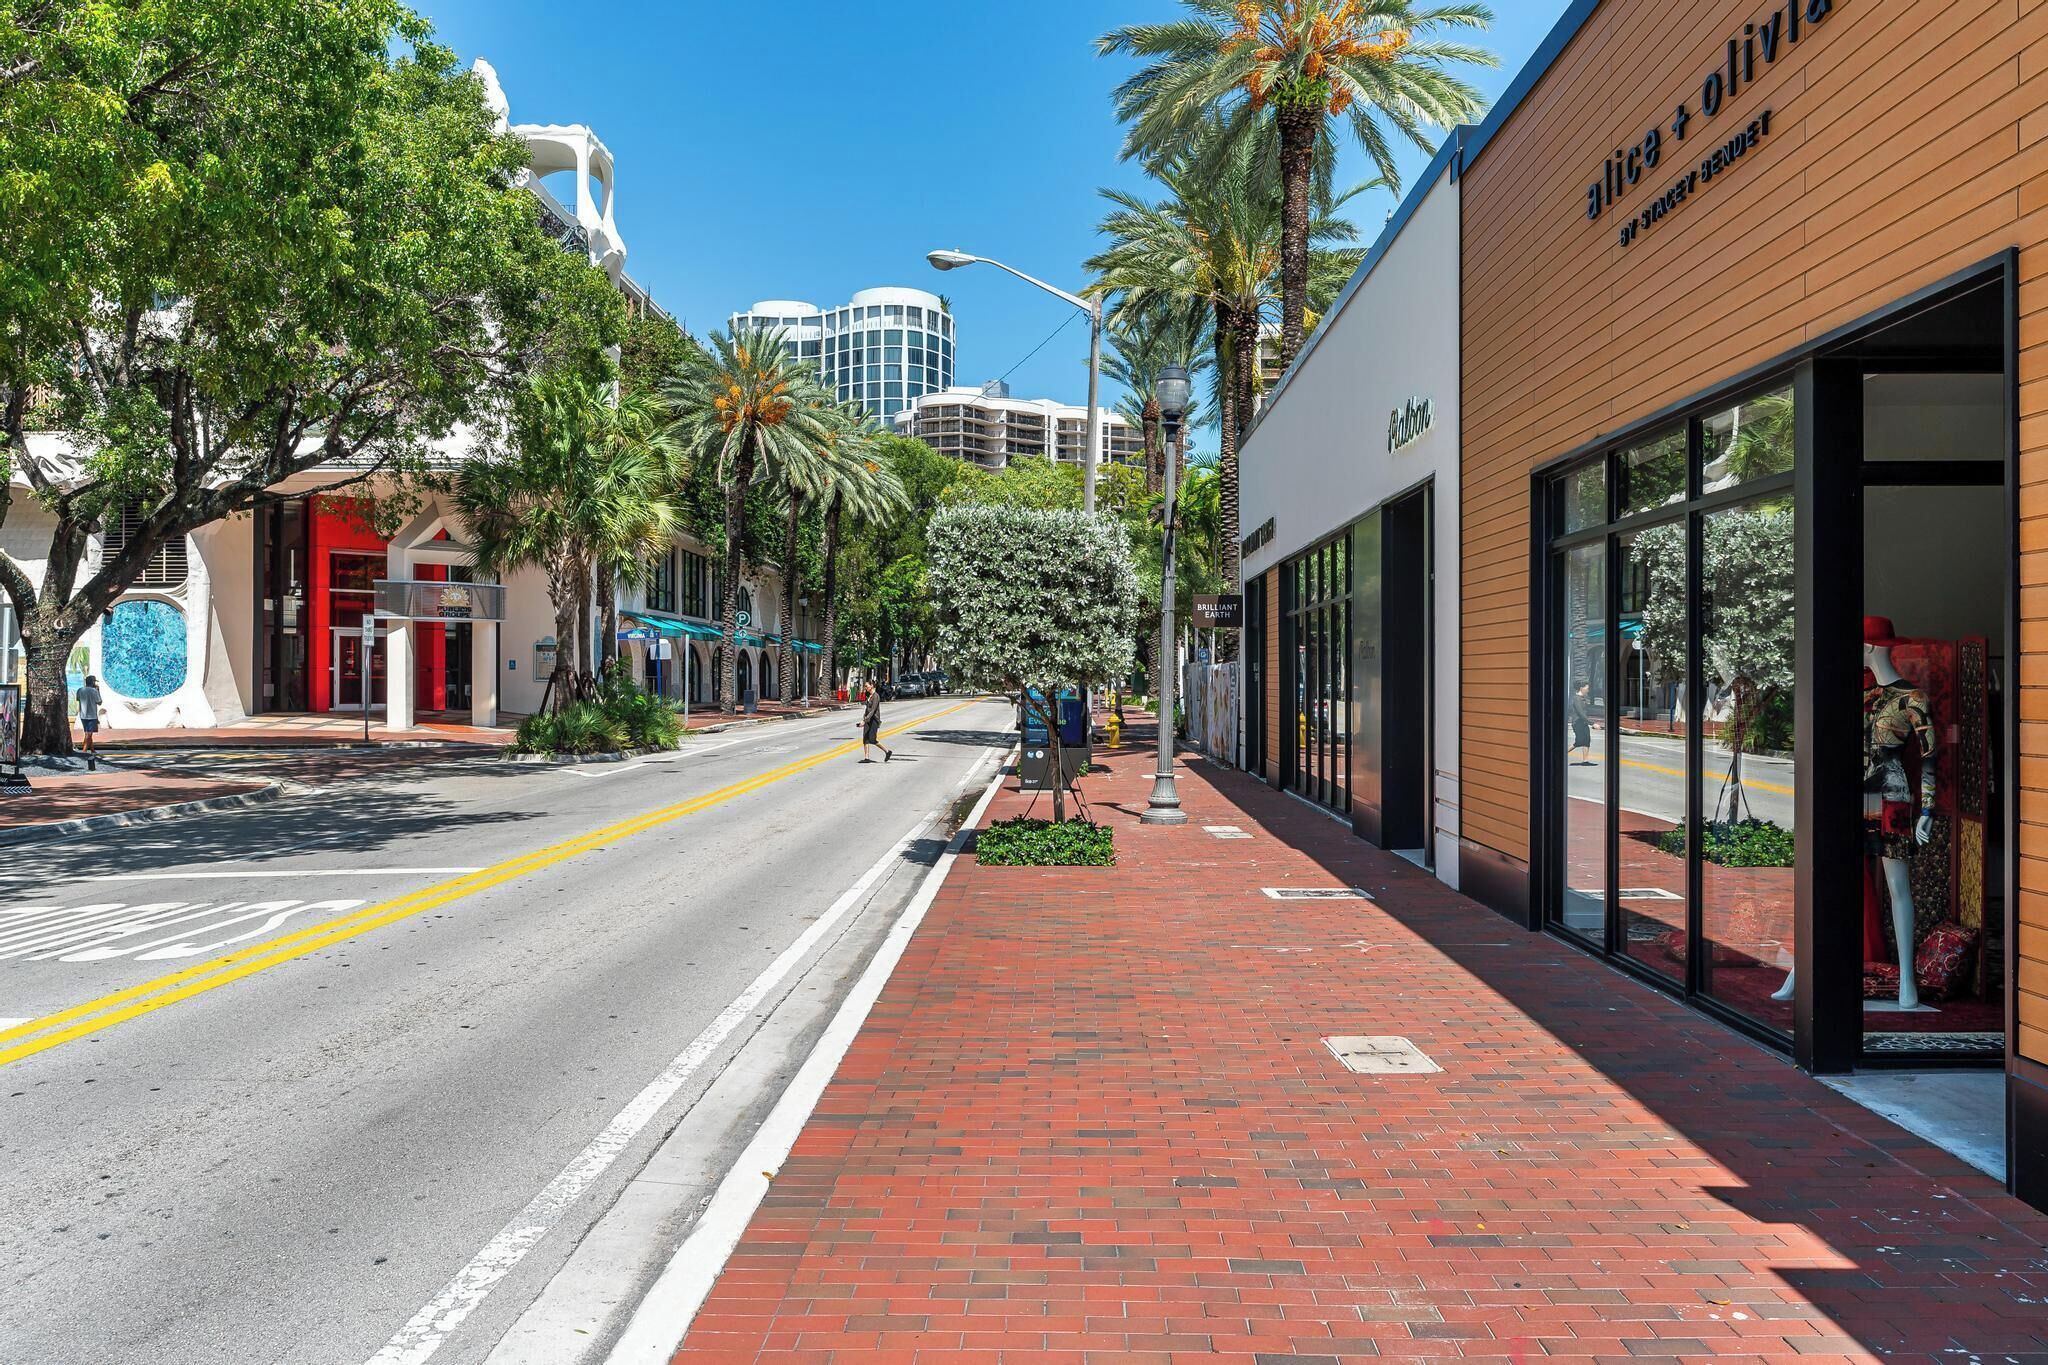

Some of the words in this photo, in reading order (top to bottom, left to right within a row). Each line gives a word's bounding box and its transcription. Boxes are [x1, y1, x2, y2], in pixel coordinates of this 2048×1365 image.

[1587, 129, 1661, 219] alice
[1620, 218, 1638, 247] BY
[1641, 170, 1697, 229] STACEY
[1701, 110, 1771, 183] BENDET
[1197, 603, 1238, 611] BRILLIANT
[0, 899, 367, 962] SCHOO
